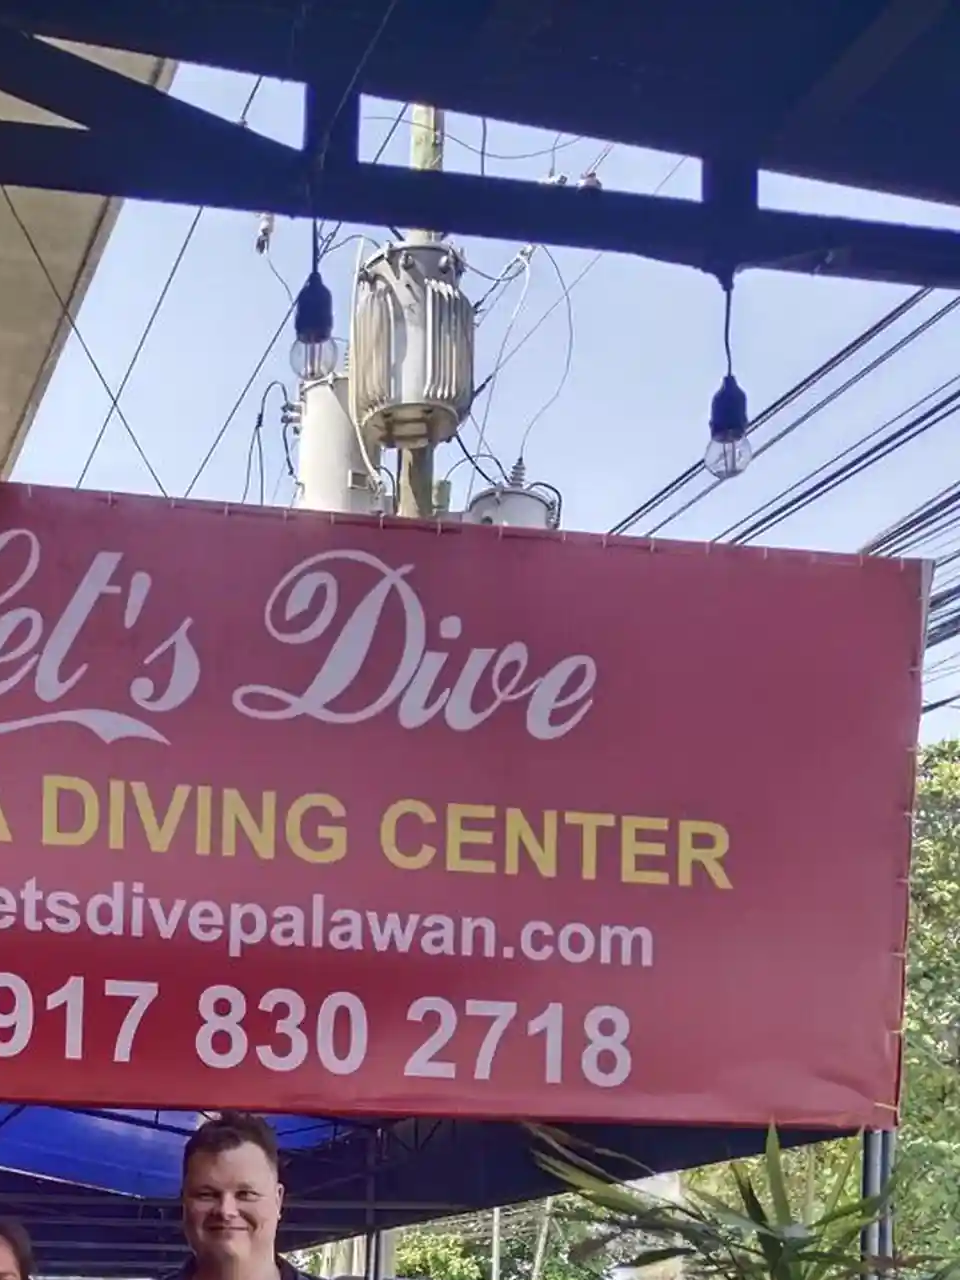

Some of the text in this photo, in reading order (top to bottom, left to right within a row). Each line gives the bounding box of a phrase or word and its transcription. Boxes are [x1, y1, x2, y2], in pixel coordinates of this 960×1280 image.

[233, 549, 598, 741] Dive
[41, 775, 348, 864] DIVING
[379, 798, 734, 889] CENTER
[195, 985, 369, 1075] 830
[403, 996, 632, 1088] 2718
